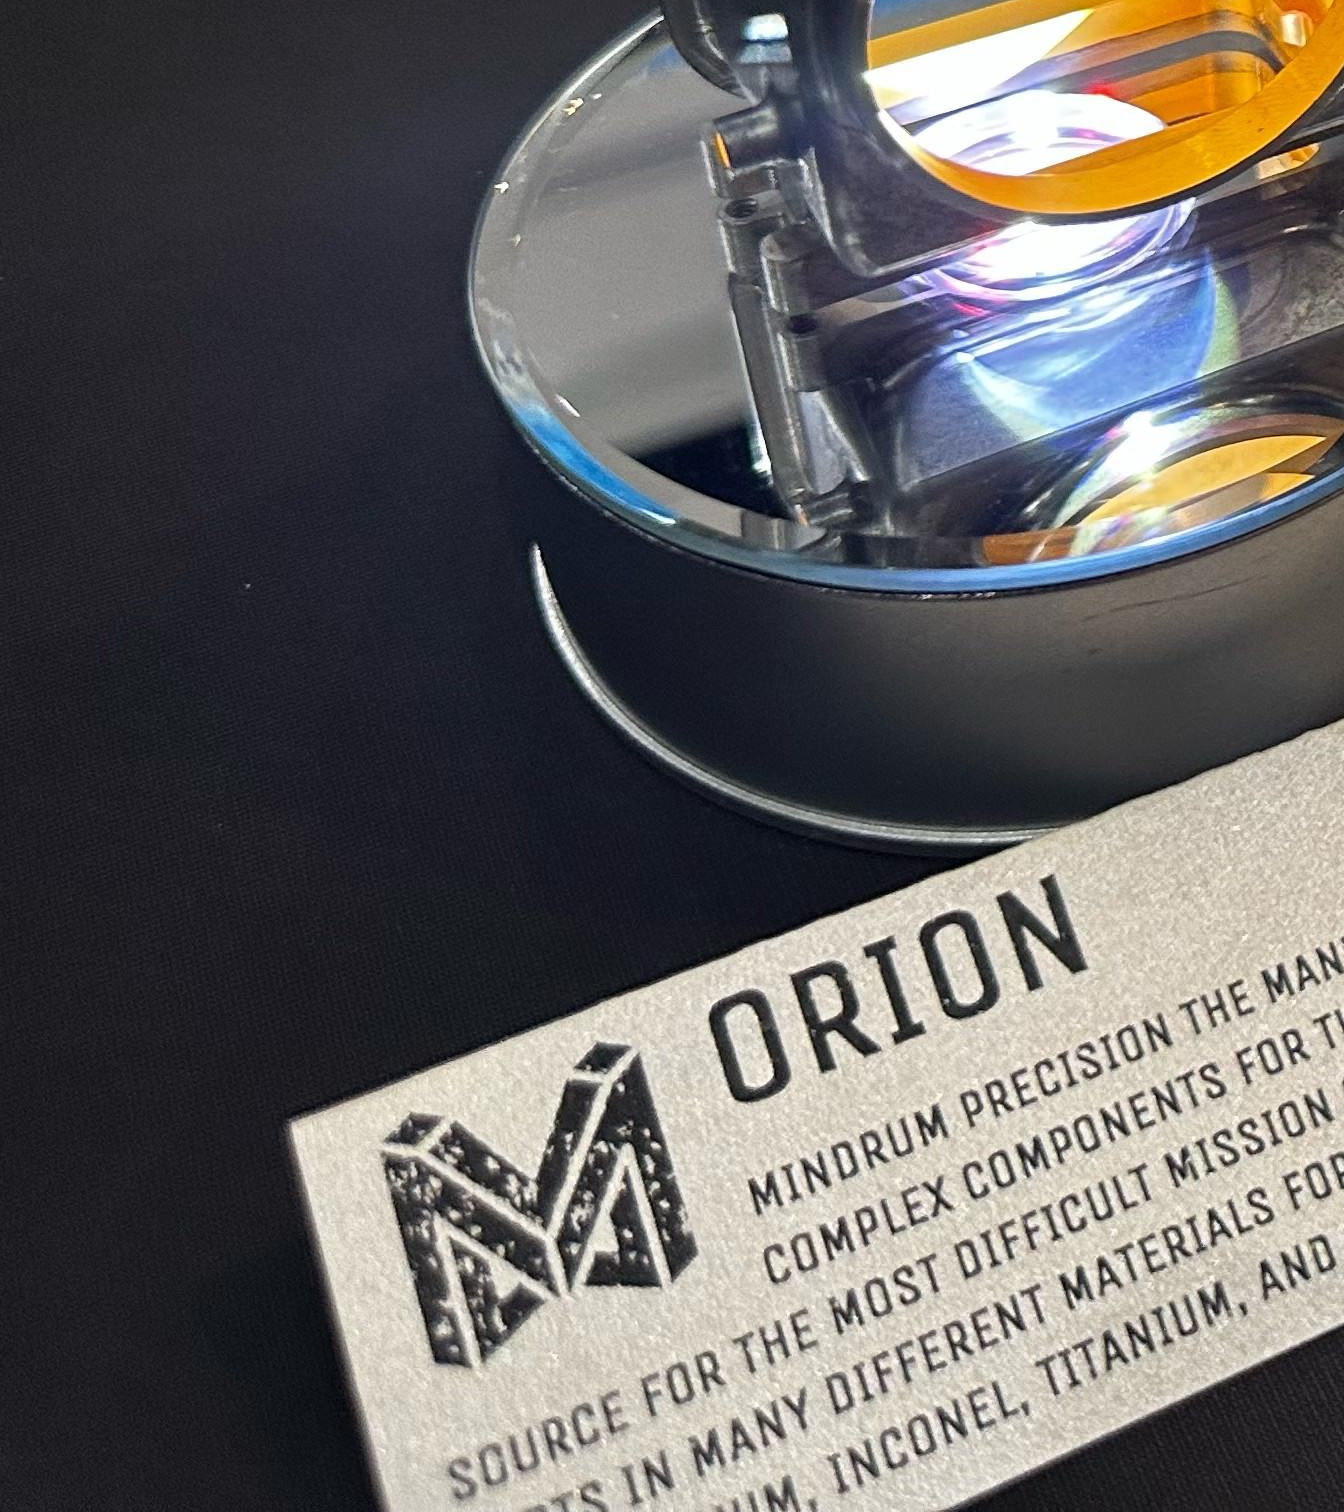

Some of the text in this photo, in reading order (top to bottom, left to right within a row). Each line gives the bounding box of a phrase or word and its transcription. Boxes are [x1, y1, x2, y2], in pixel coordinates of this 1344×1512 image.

[708, 872, 1090, 1103] ORION
[746, 1102, 950, 1220] MINDRUM
[958, 1009, 1174, 1130] PRECISION
[1175, 974, 1257, 1037] THE
[760, 1173, 955, 1288] COMPLEX
[959, 1057, 1228, 1202] COMPONENTS
[1230, 1023, 1309, 1084] FOR
[446, 1390, 631, 1506] SOURCE
[638, 1348, 726, 1420] FOR
[733, 1308, 819, 1378] THE
[827, 1252, 947, 1336] MOST
[954, 1160, 1157, 1280] DIFFICULT
[1162, 1084, 1333, 1187] MISSION
[622, 1453, 672, 1509] IN
[689, 1388, 817, 1478] MANY
[827, 1282, 1052, 1415] DIFFERENT
[1057, 1182, 1276, 1310] MATERIALS
[827, 1371, 1030, 1496] INCONEL,
[1034, 1271, 1248, 1400] TITANIUM,
[1250, 1230, 1338, 1299] AND
